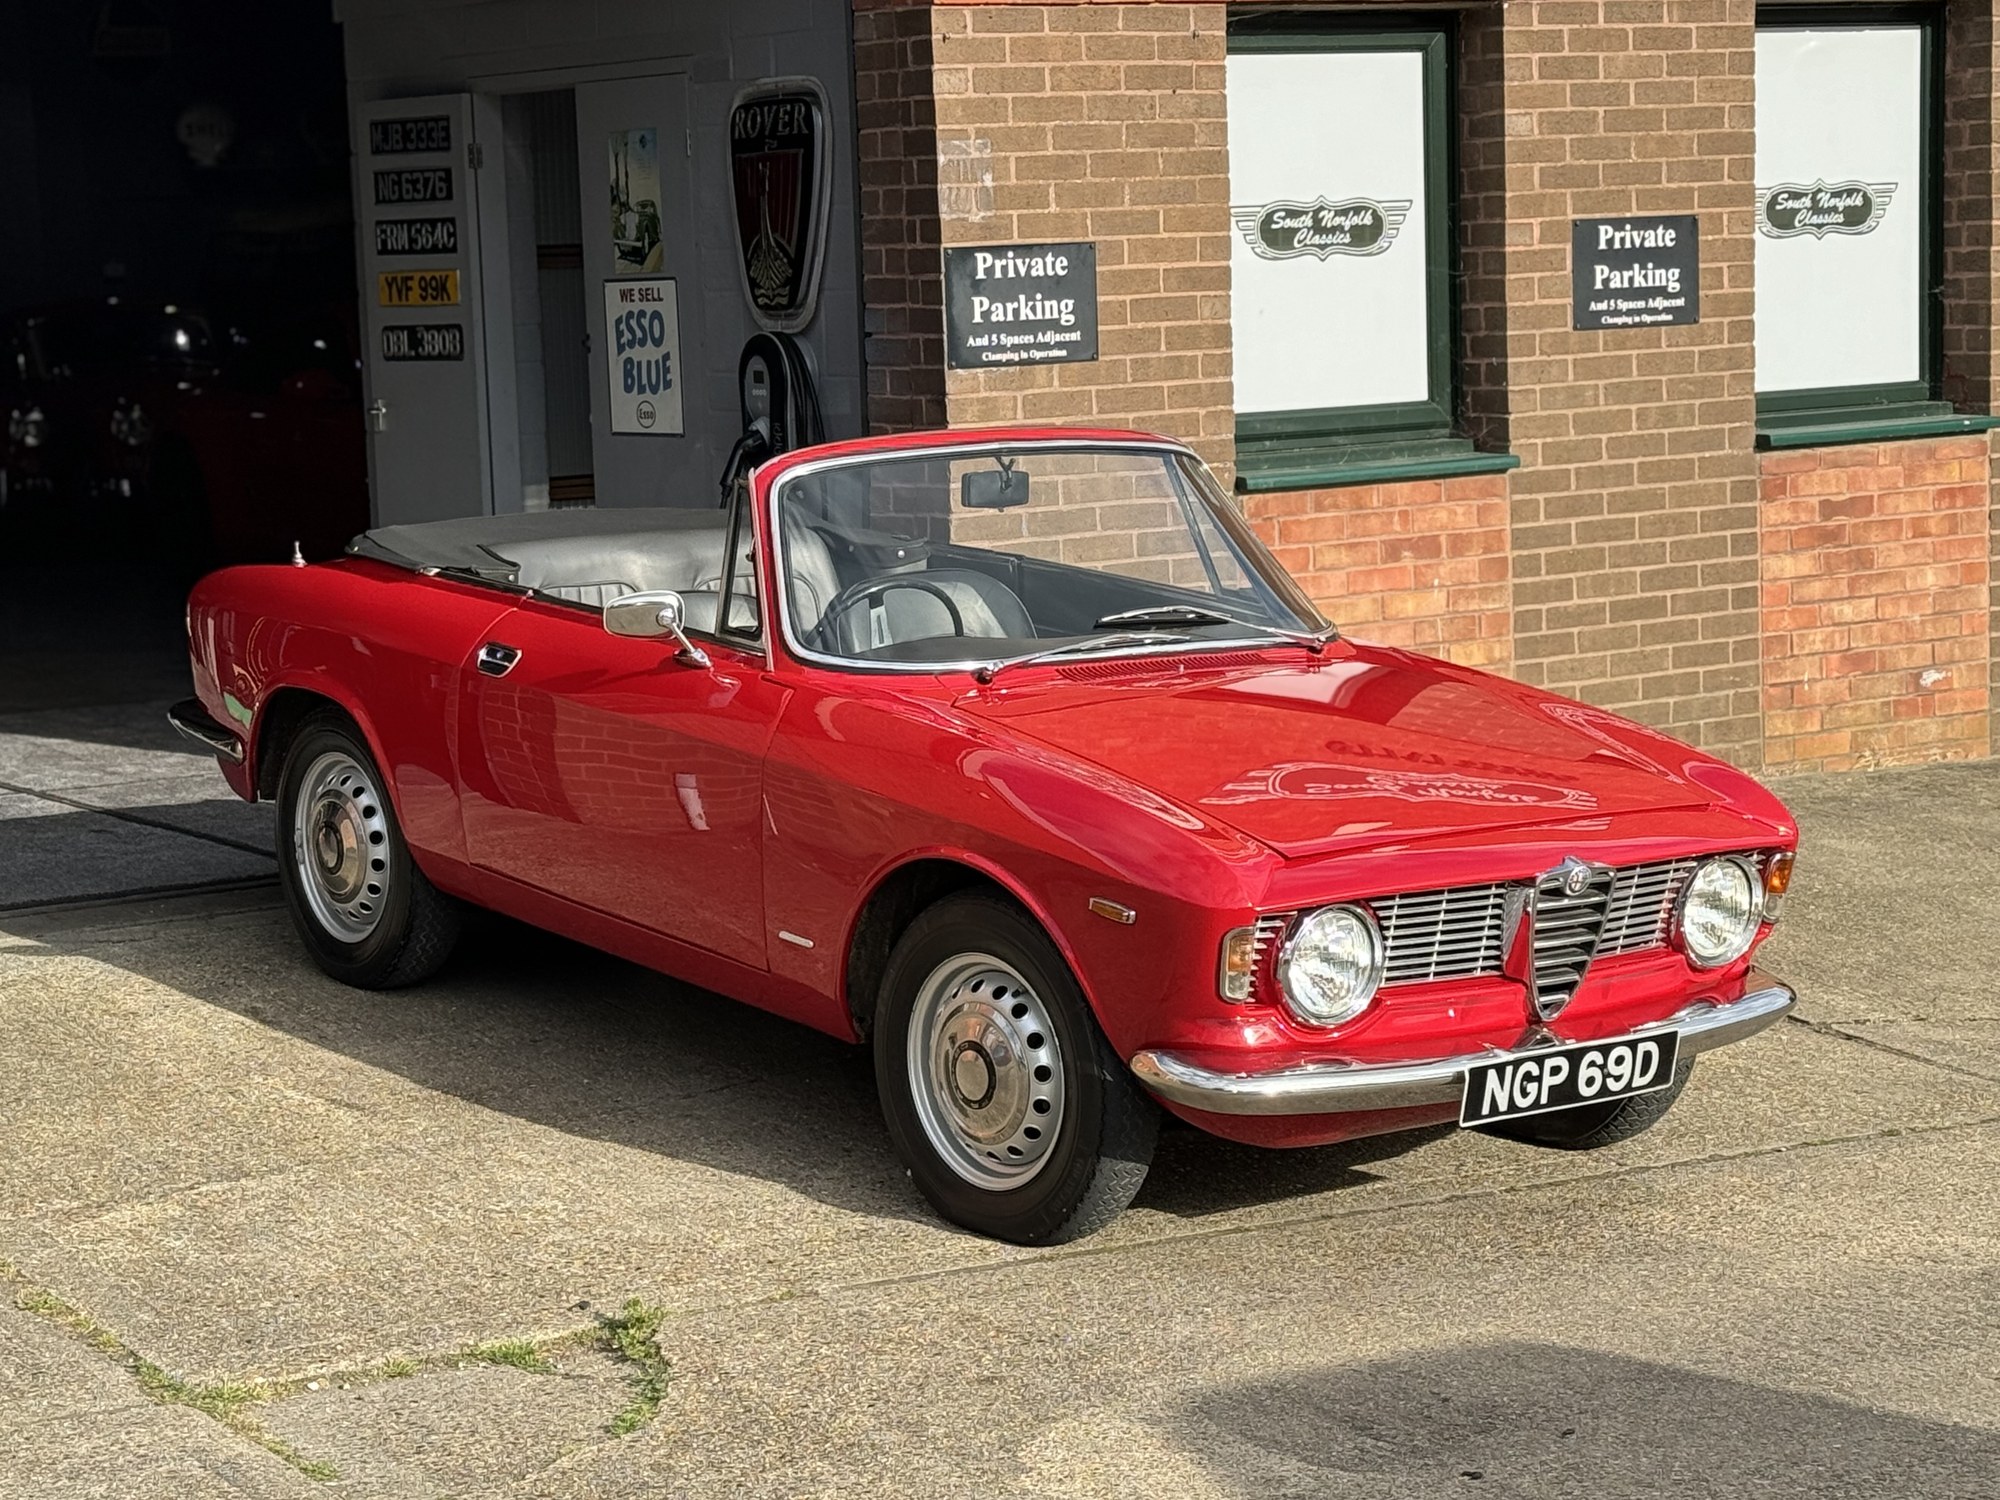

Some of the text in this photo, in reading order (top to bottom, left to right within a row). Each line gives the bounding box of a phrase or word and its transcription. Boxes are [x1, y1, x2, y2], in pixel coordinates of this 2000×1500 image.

[734, 102, 810, 141] ROVER
[371, 120, 449, 153] MJB 333E
[377, 171, 447, 201] NG 6376
[1775, 191, 1864, 212] South Norfolk
[1271, 209, 1374, 231] South Norfolk
[1794, 209, 1844, 228] Classics
[376, 221, 455, 251] FRM 564C
[1293, 228, 1352, 248] Classics
[1597, 223, 1676, 250] Private
[974, 251, 1068, 279] Private
[1593, 262, 1680, 293] Parking
[385, 274, 452, 303] YVF 99K
[619, 287, 664, 303] WE SELL
[970, 293, 1075, 326] Parking
[1588, 296, 1686, 312] And 5 Spaces Adjacent
[615, 309, 665, 357] ESSO
[966, 330, 1081, 348] And 5 Spaces Adjacent
[982, 351, 1020, 363] Clamping
[1029, 348, 1068, 360] Operation
[623, 351, 673, 395] BLUE
[1481, 1041, 1660, 1116] NGP 69D
